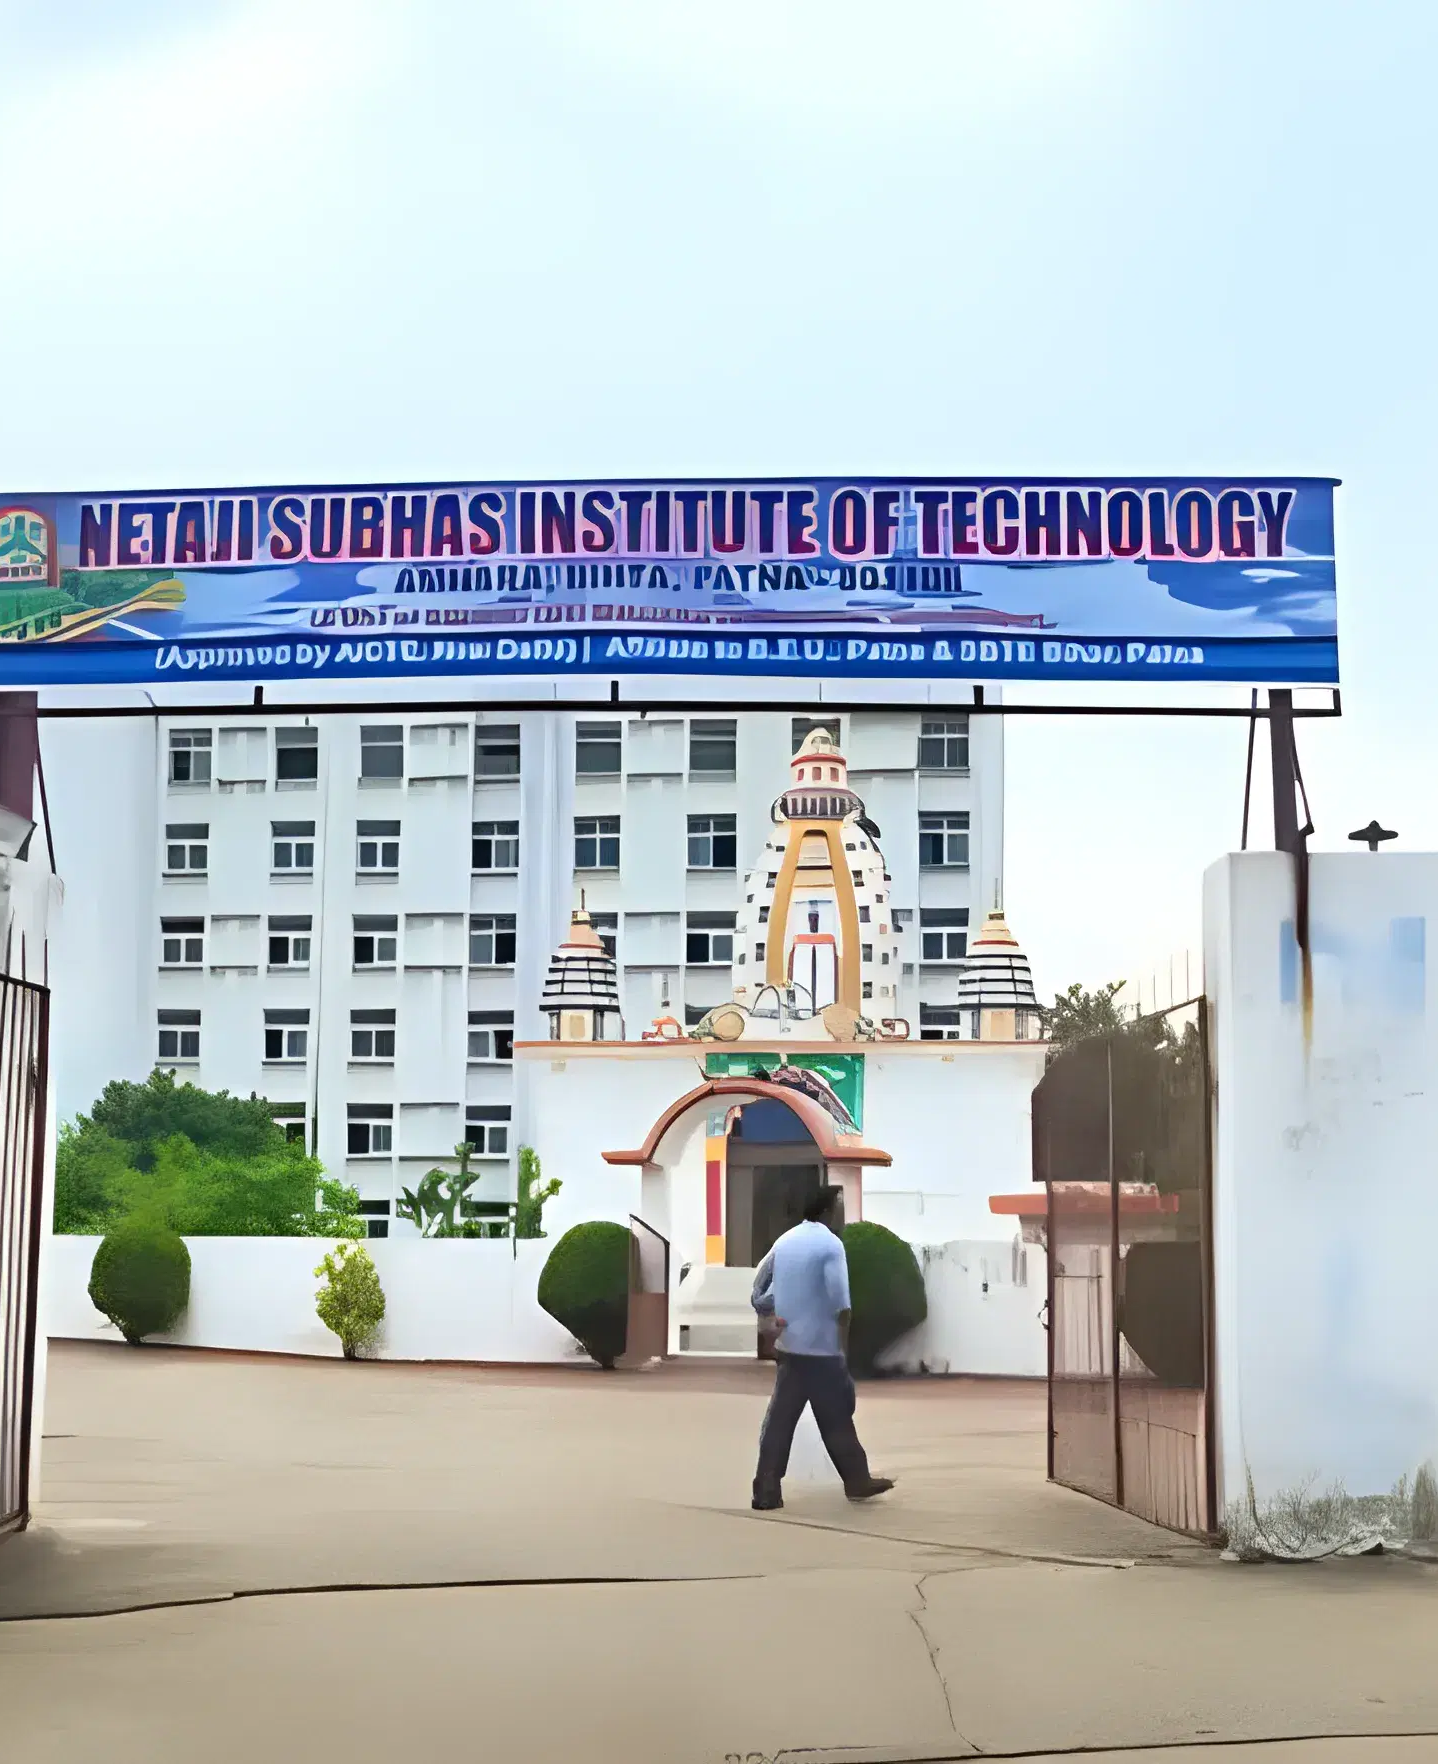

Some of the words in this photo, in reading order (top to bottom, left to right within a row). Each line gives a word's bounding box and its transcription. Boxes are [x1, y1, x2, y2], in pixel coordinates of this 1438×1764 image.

[77, 497, 256, 568] NETAJI
[268, 491, 503, 562] SUBHAS
[519, 488, 816, 558] INSTITUTE
[830, 488, 905, 556] OF
[913, 488, 1295, 559] TECHNOLOGY
